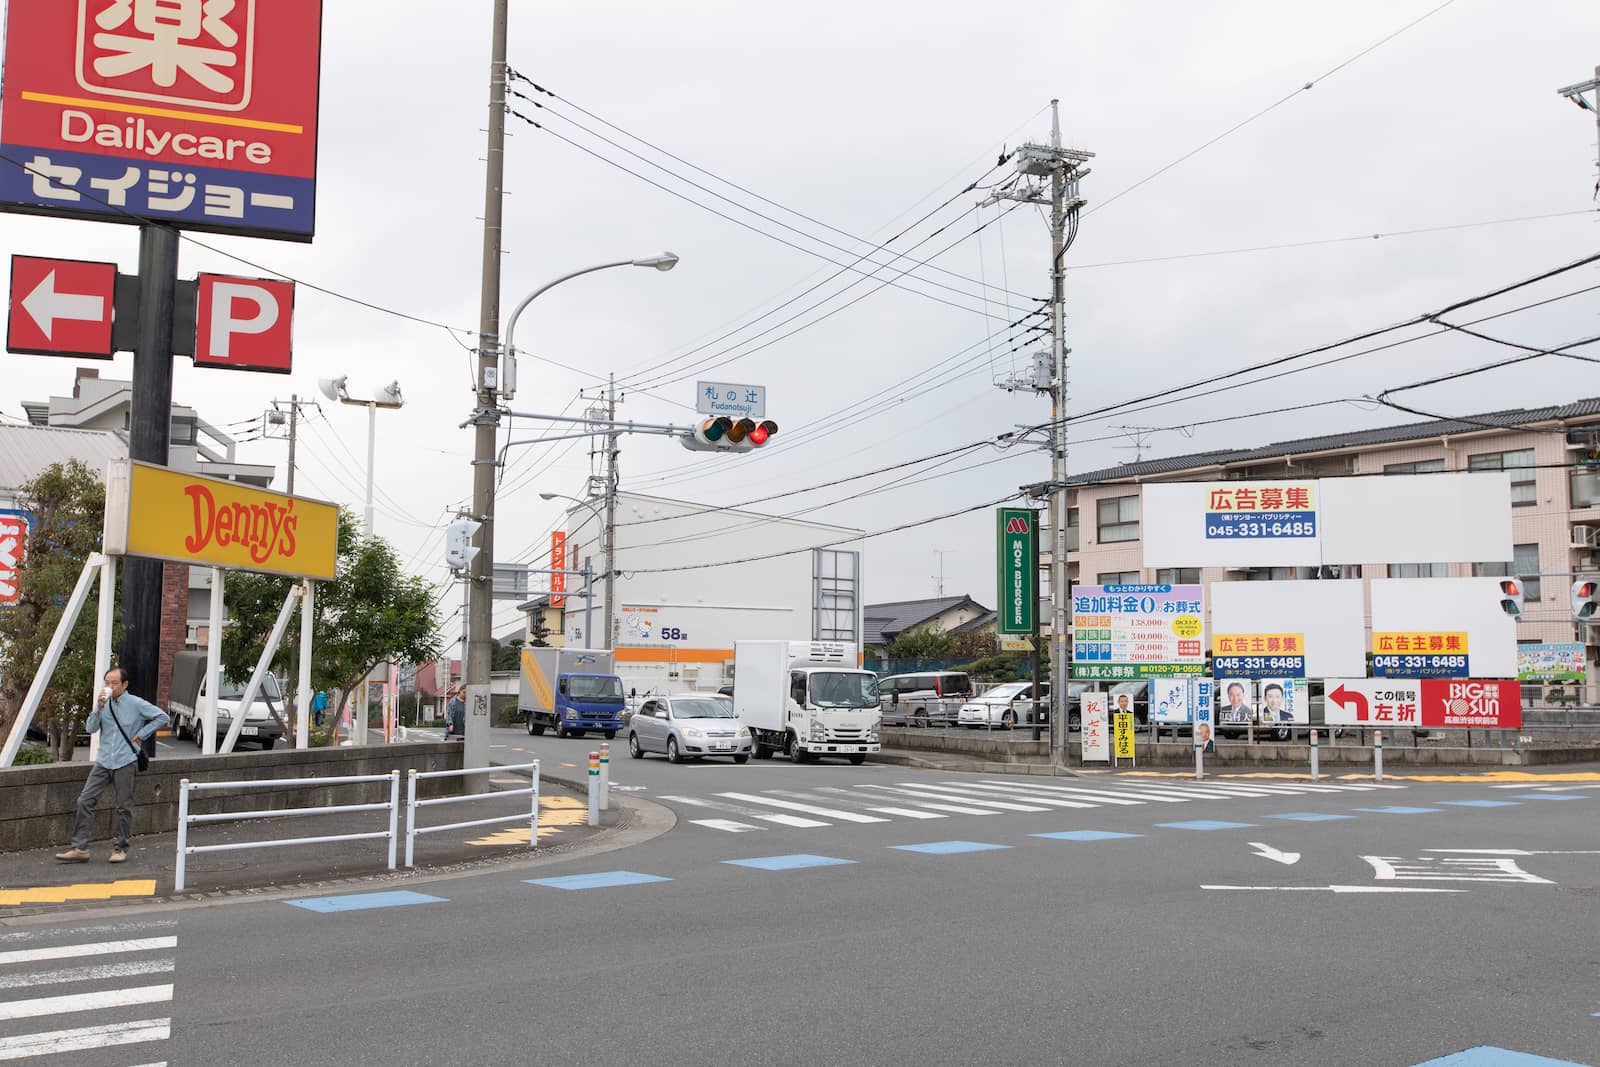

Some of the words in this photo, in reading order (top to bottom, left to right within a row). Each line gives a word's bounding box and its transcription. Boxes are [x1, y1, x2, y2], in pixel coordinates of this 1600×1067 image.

[61, 110, 272, 165] Dailycare
[24, 155, 294, 218] セイジョー
[209, 281, 280, 358] P
[705, 386, 758, 404] 札の辻
[711, 401, 752, 413] Fudanotsuji
[1210, 487, 1310, 511] 広告募集
[184, 484, 298, 563] Denny's
[1208, 522, 1314, 536] 045-331-6485
[1012, 540, 1023, 568] MOS
[1014, 570, 1023, 625] BURGER
[1220, 637, 1297, 652] 広告主募集
[1379, 636, 1461, 650] 広告主募集
[1216, 657, 1302, 669] 045-331-6485
[1375, 656, 1465, 668] 045-331-6485
[1374, 690, 1416, 701] この信号
[1449, 683, 1483, 699] BIG
[1198, 682, 1210, 722] 甘利明
[1374, 703, 1416, 722] 左折
